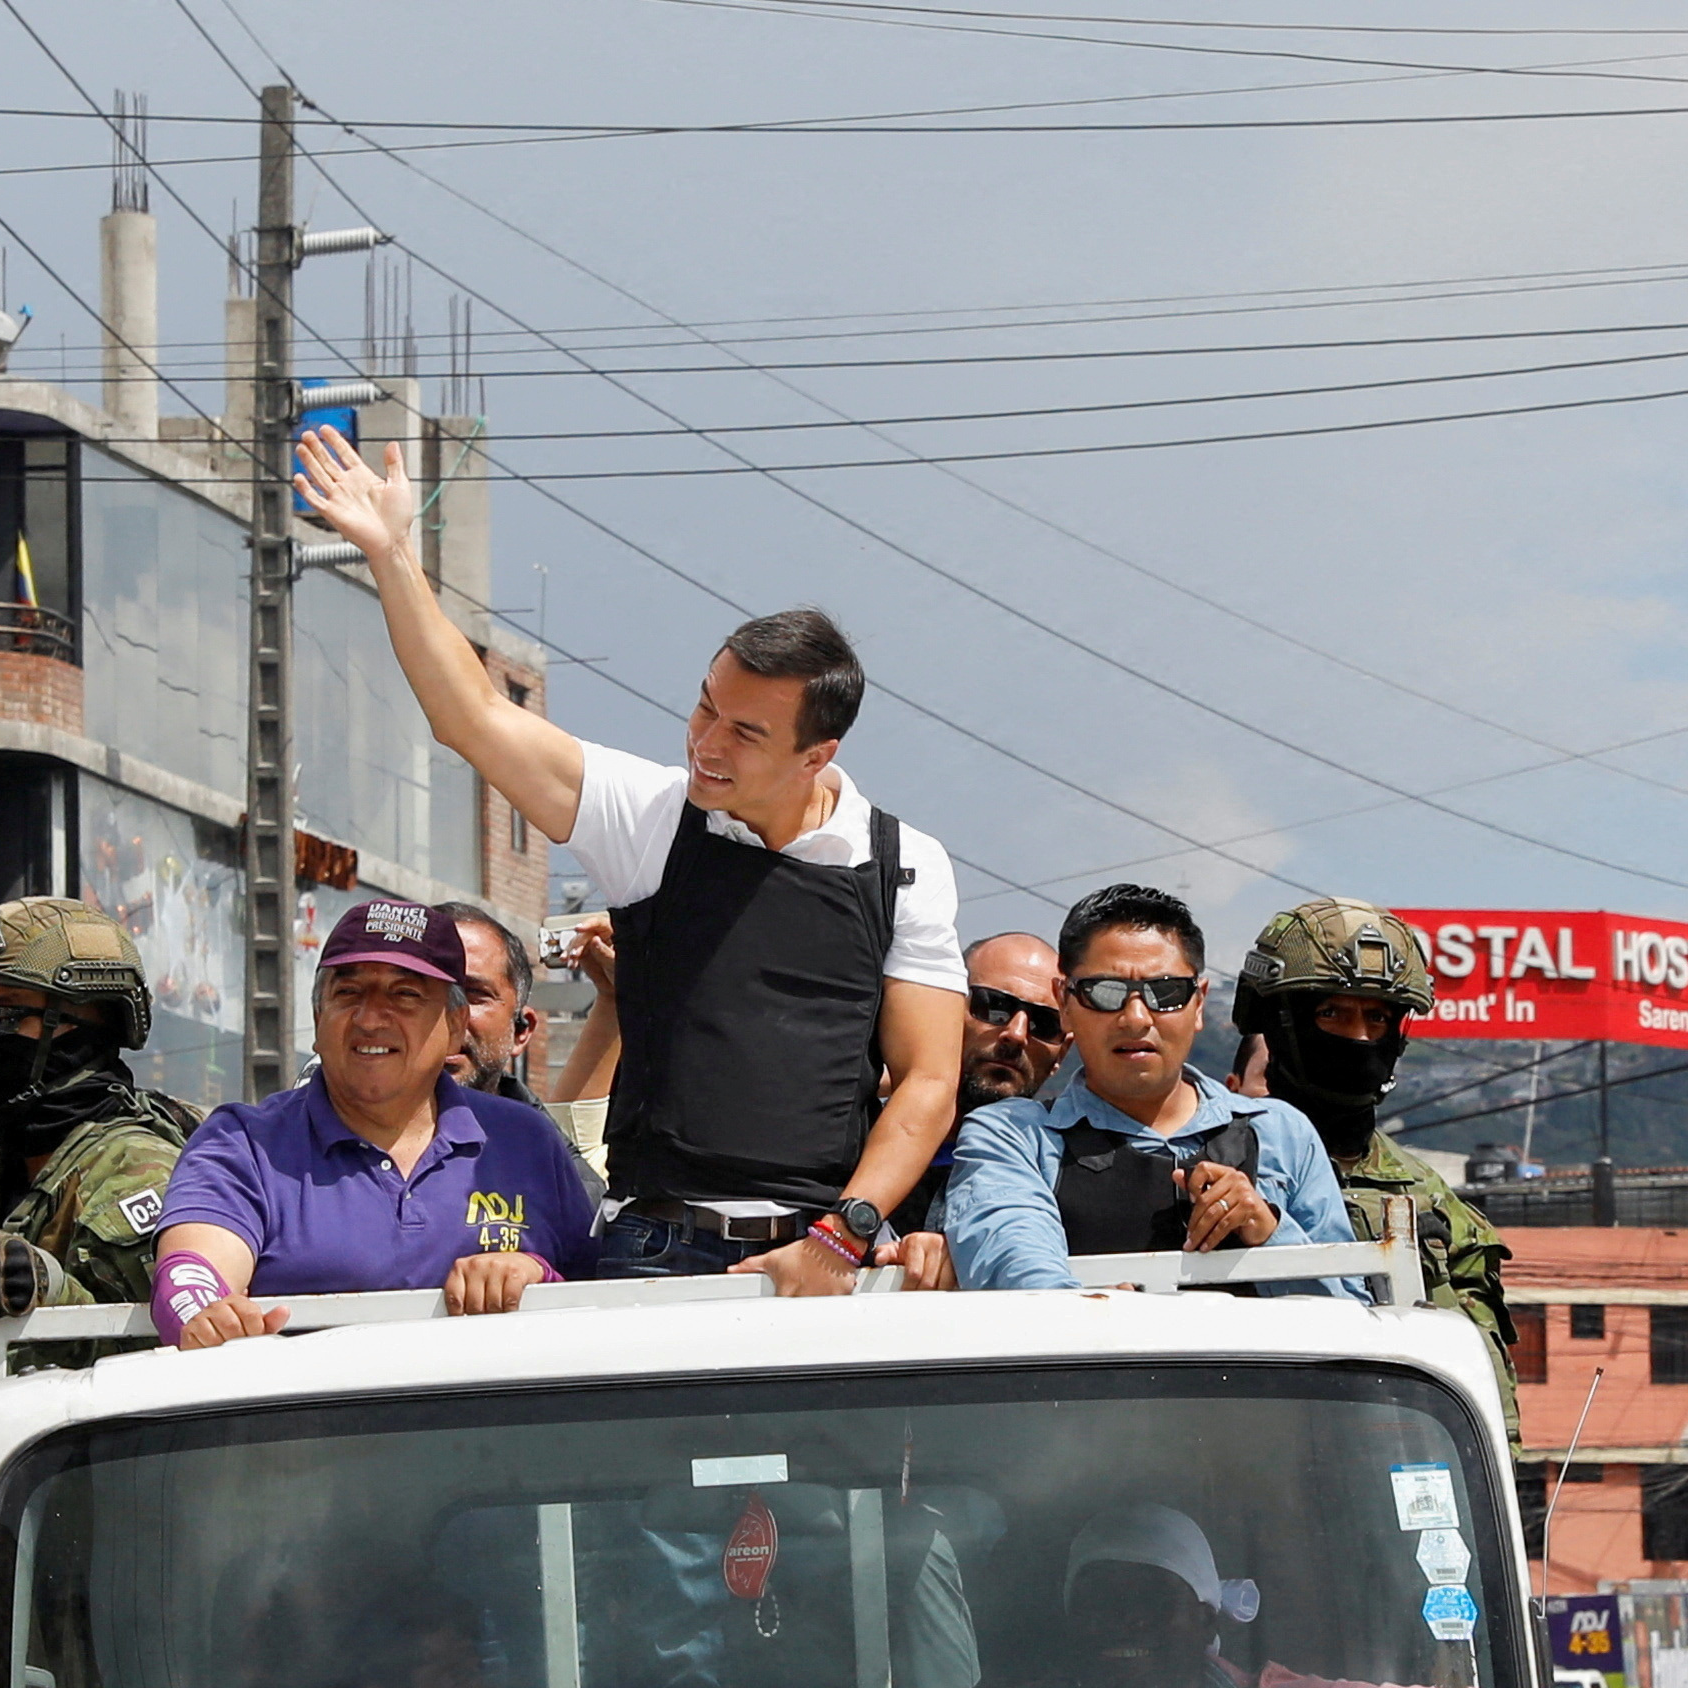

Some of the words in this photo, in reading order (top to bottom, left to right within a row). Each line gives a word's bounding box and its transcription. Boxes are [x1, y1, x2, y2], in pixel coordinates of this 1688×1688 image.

[367, 912, 401, 922] NOBOA
[369, 903, 425, 919] DANIEL
[366, 921, 424, 941] PRESIDENTE
[1505, 988, 1535, 1023] In
[479, 1226, 520, 1252] 4-35
[729, 1544, 770, 1557] areon
[1569, 1630, 1613, 1655] 4-35
